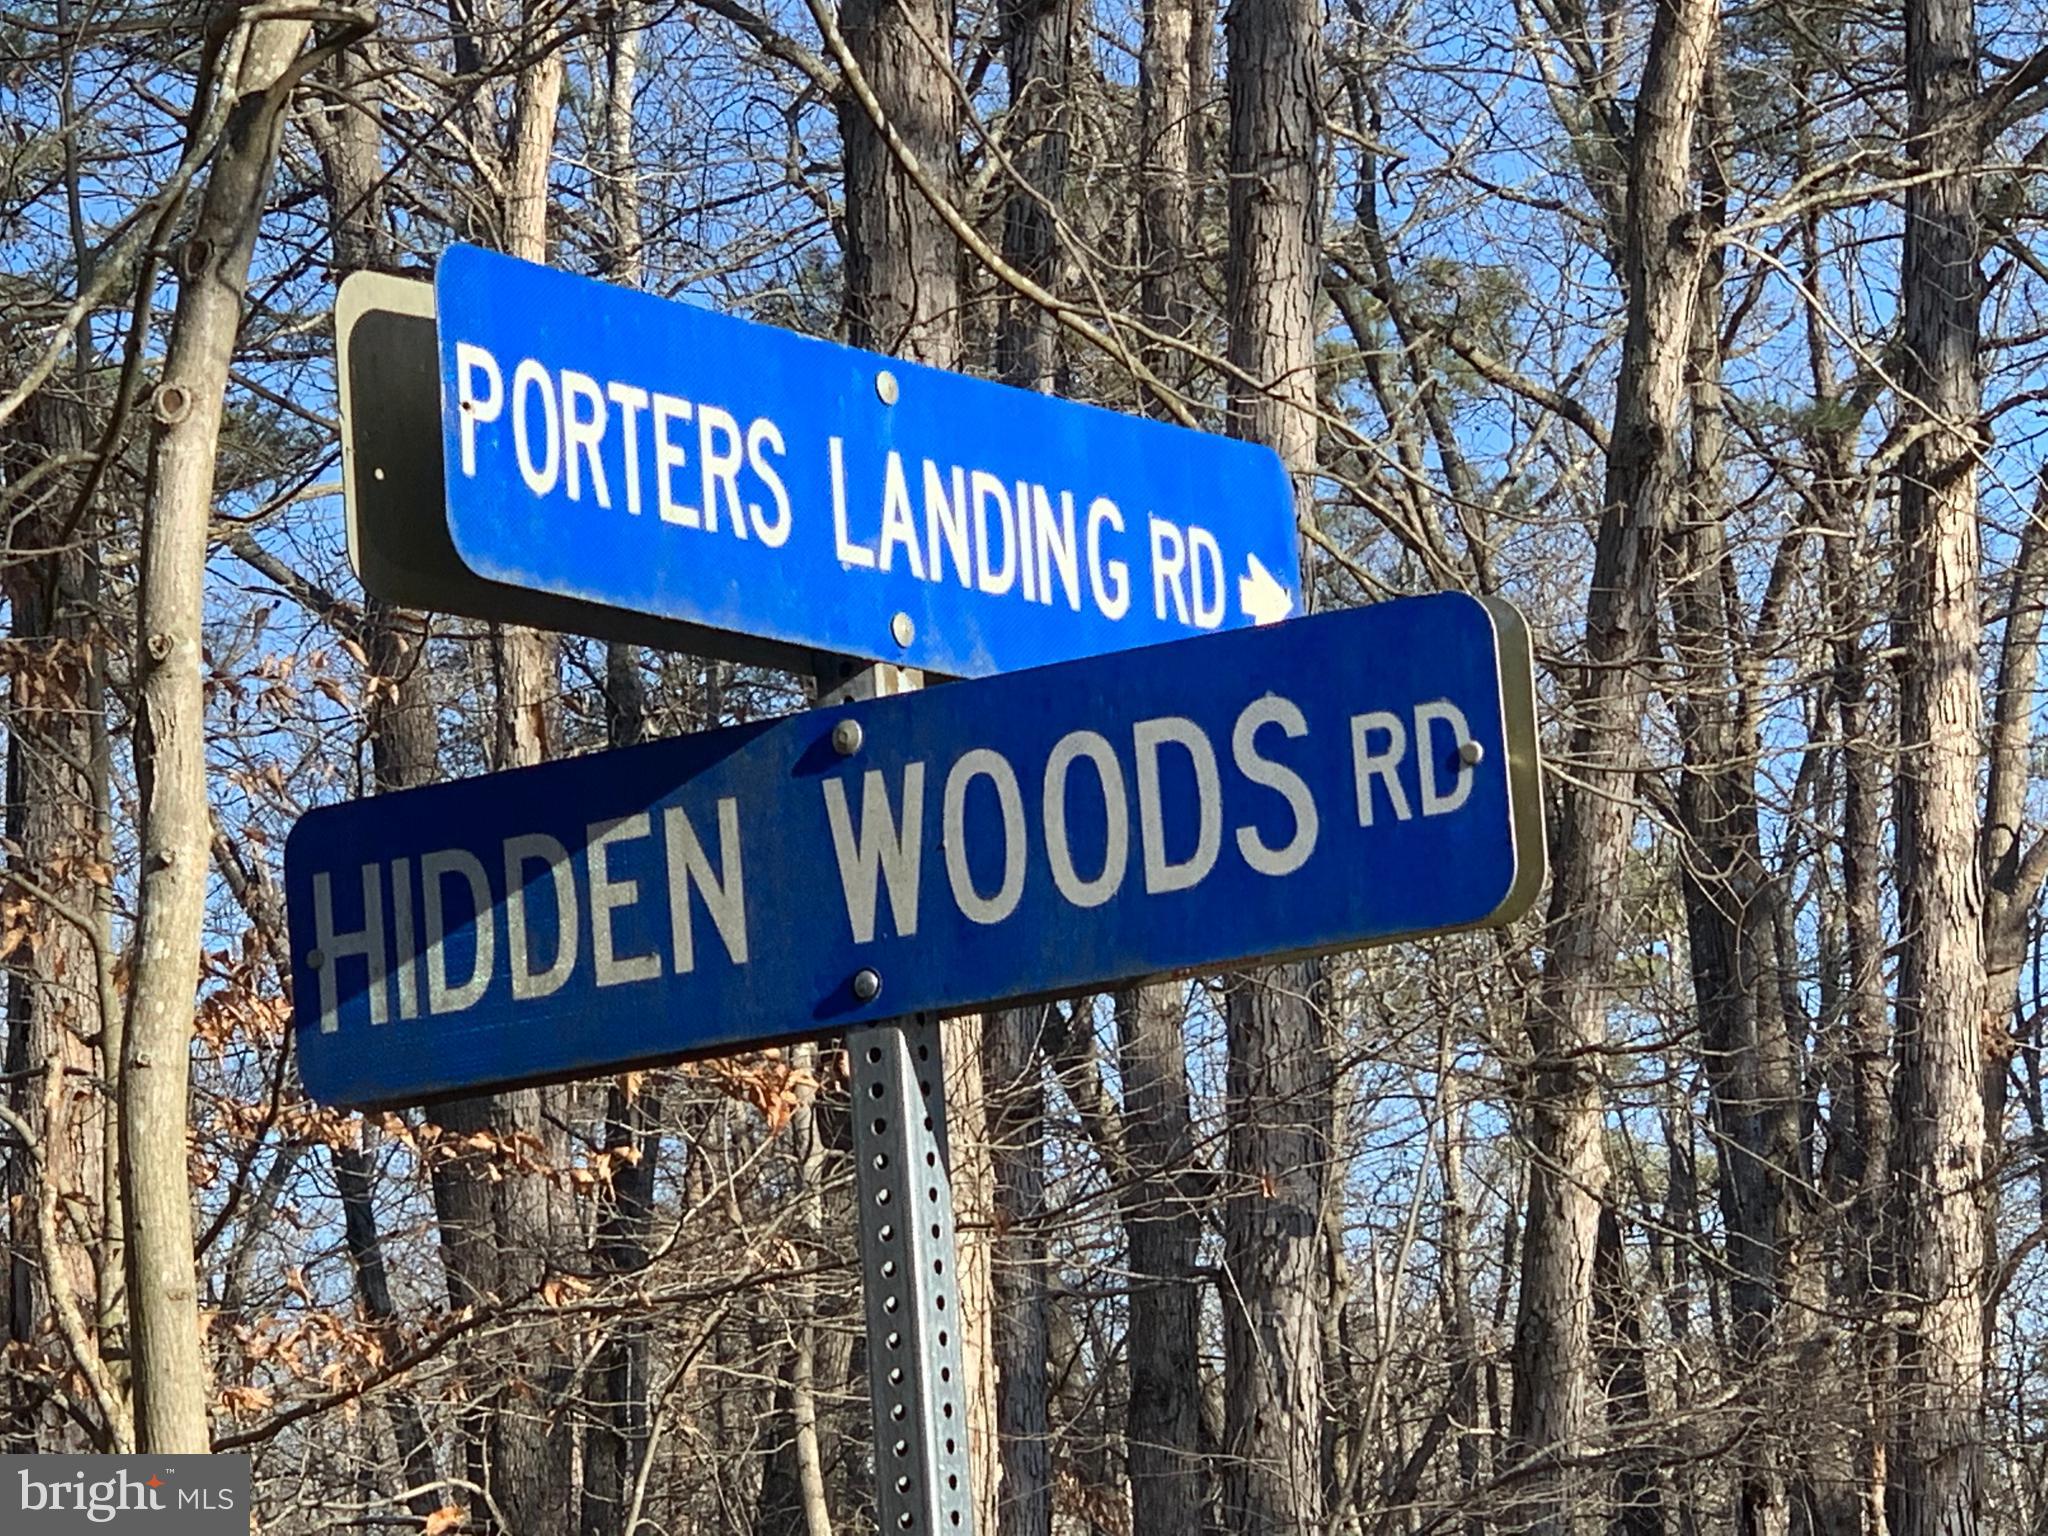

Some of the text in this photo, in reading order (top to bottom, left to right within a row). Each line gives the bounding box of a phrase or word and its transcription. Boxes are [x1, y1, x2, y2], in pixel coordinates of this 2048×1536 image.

[455, 342, 1225, 629] PORTERS LANDING RD
[313, 693, 1476, 1033] HIDDEN WOODS RD
